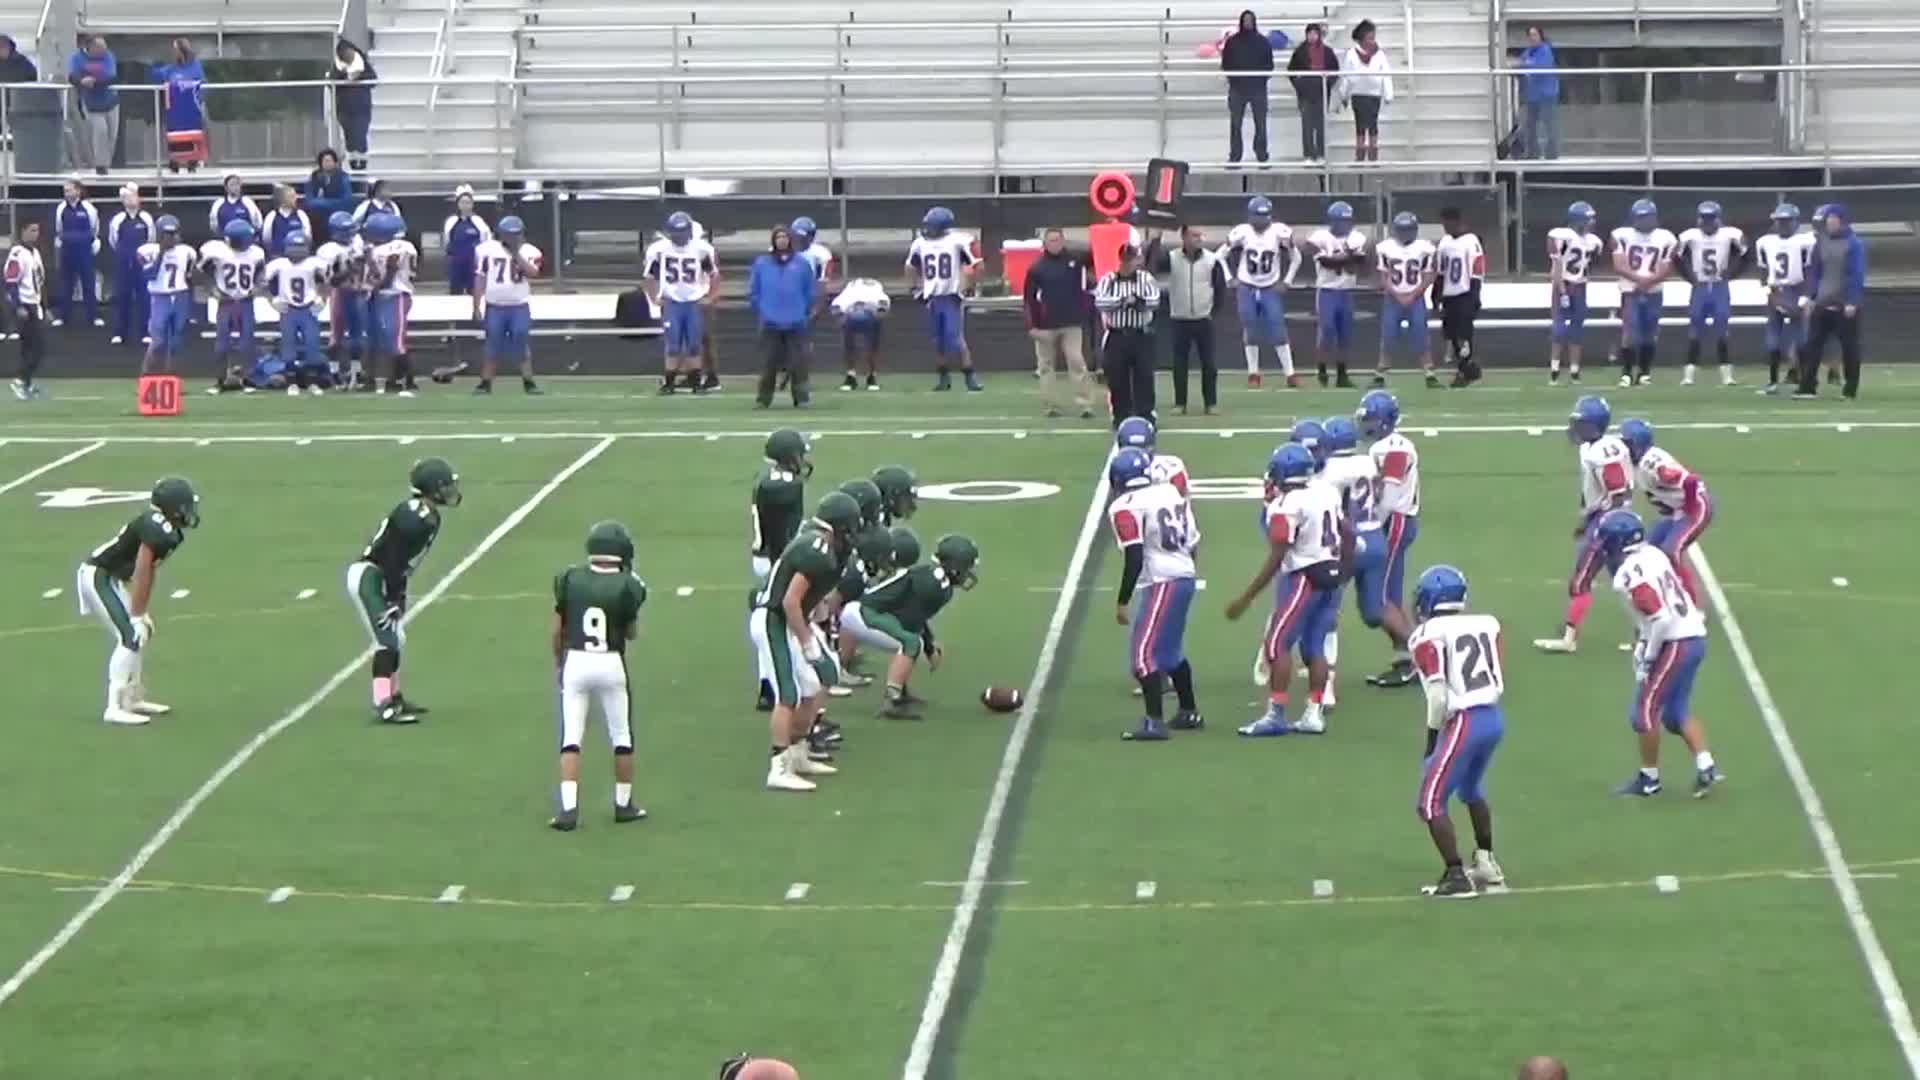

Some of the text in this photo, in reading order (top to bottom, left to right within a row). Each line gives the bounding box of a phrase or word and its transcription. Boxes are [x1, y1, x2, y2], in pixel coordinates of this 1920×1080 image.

[664, 257, 697, 284] 55
[923, 252, 953, 281] 68
[1390, 257, 1420, 286] 56
[1629, 245, 1660, 272] 67
[1702, 249, 1718, 276] 5
[1775, 252, 1789, 279] 3
[164, 263, 178, 288] 7
[222, 263, 251, 290] 26
[290, 277, 306, 303] 9
[143, 381, 176, 410] 40
[582, 606, 608, 653] 9
[1455, 632, 1499, 692] 21
